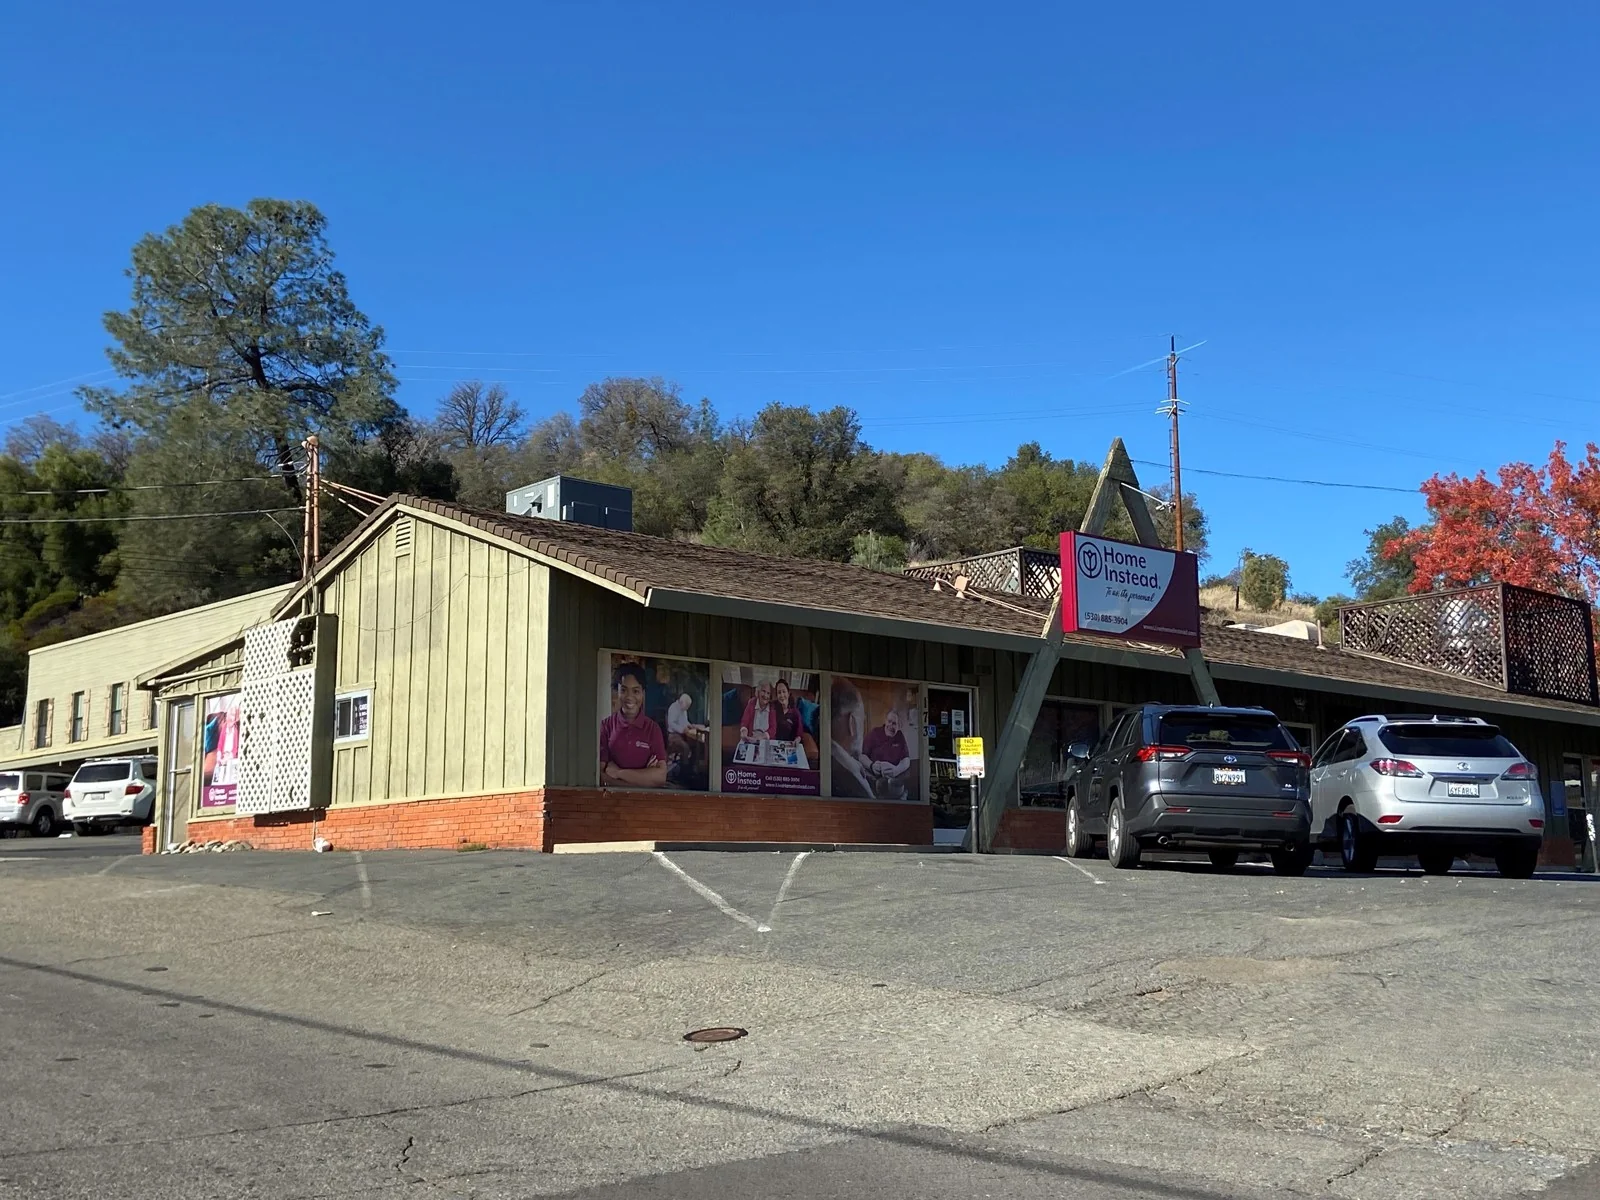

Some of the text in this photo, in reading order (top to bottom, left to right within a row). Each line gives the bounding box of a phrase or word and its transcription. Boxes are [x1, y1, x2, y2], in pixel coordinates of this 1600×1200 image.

[1103, 545, 1147, 569] Home
[1084, 611, 1128, 625] (530) 885-3904
[737, 770, 757, 778] Home
[737, 777, 761, 785] Instead
